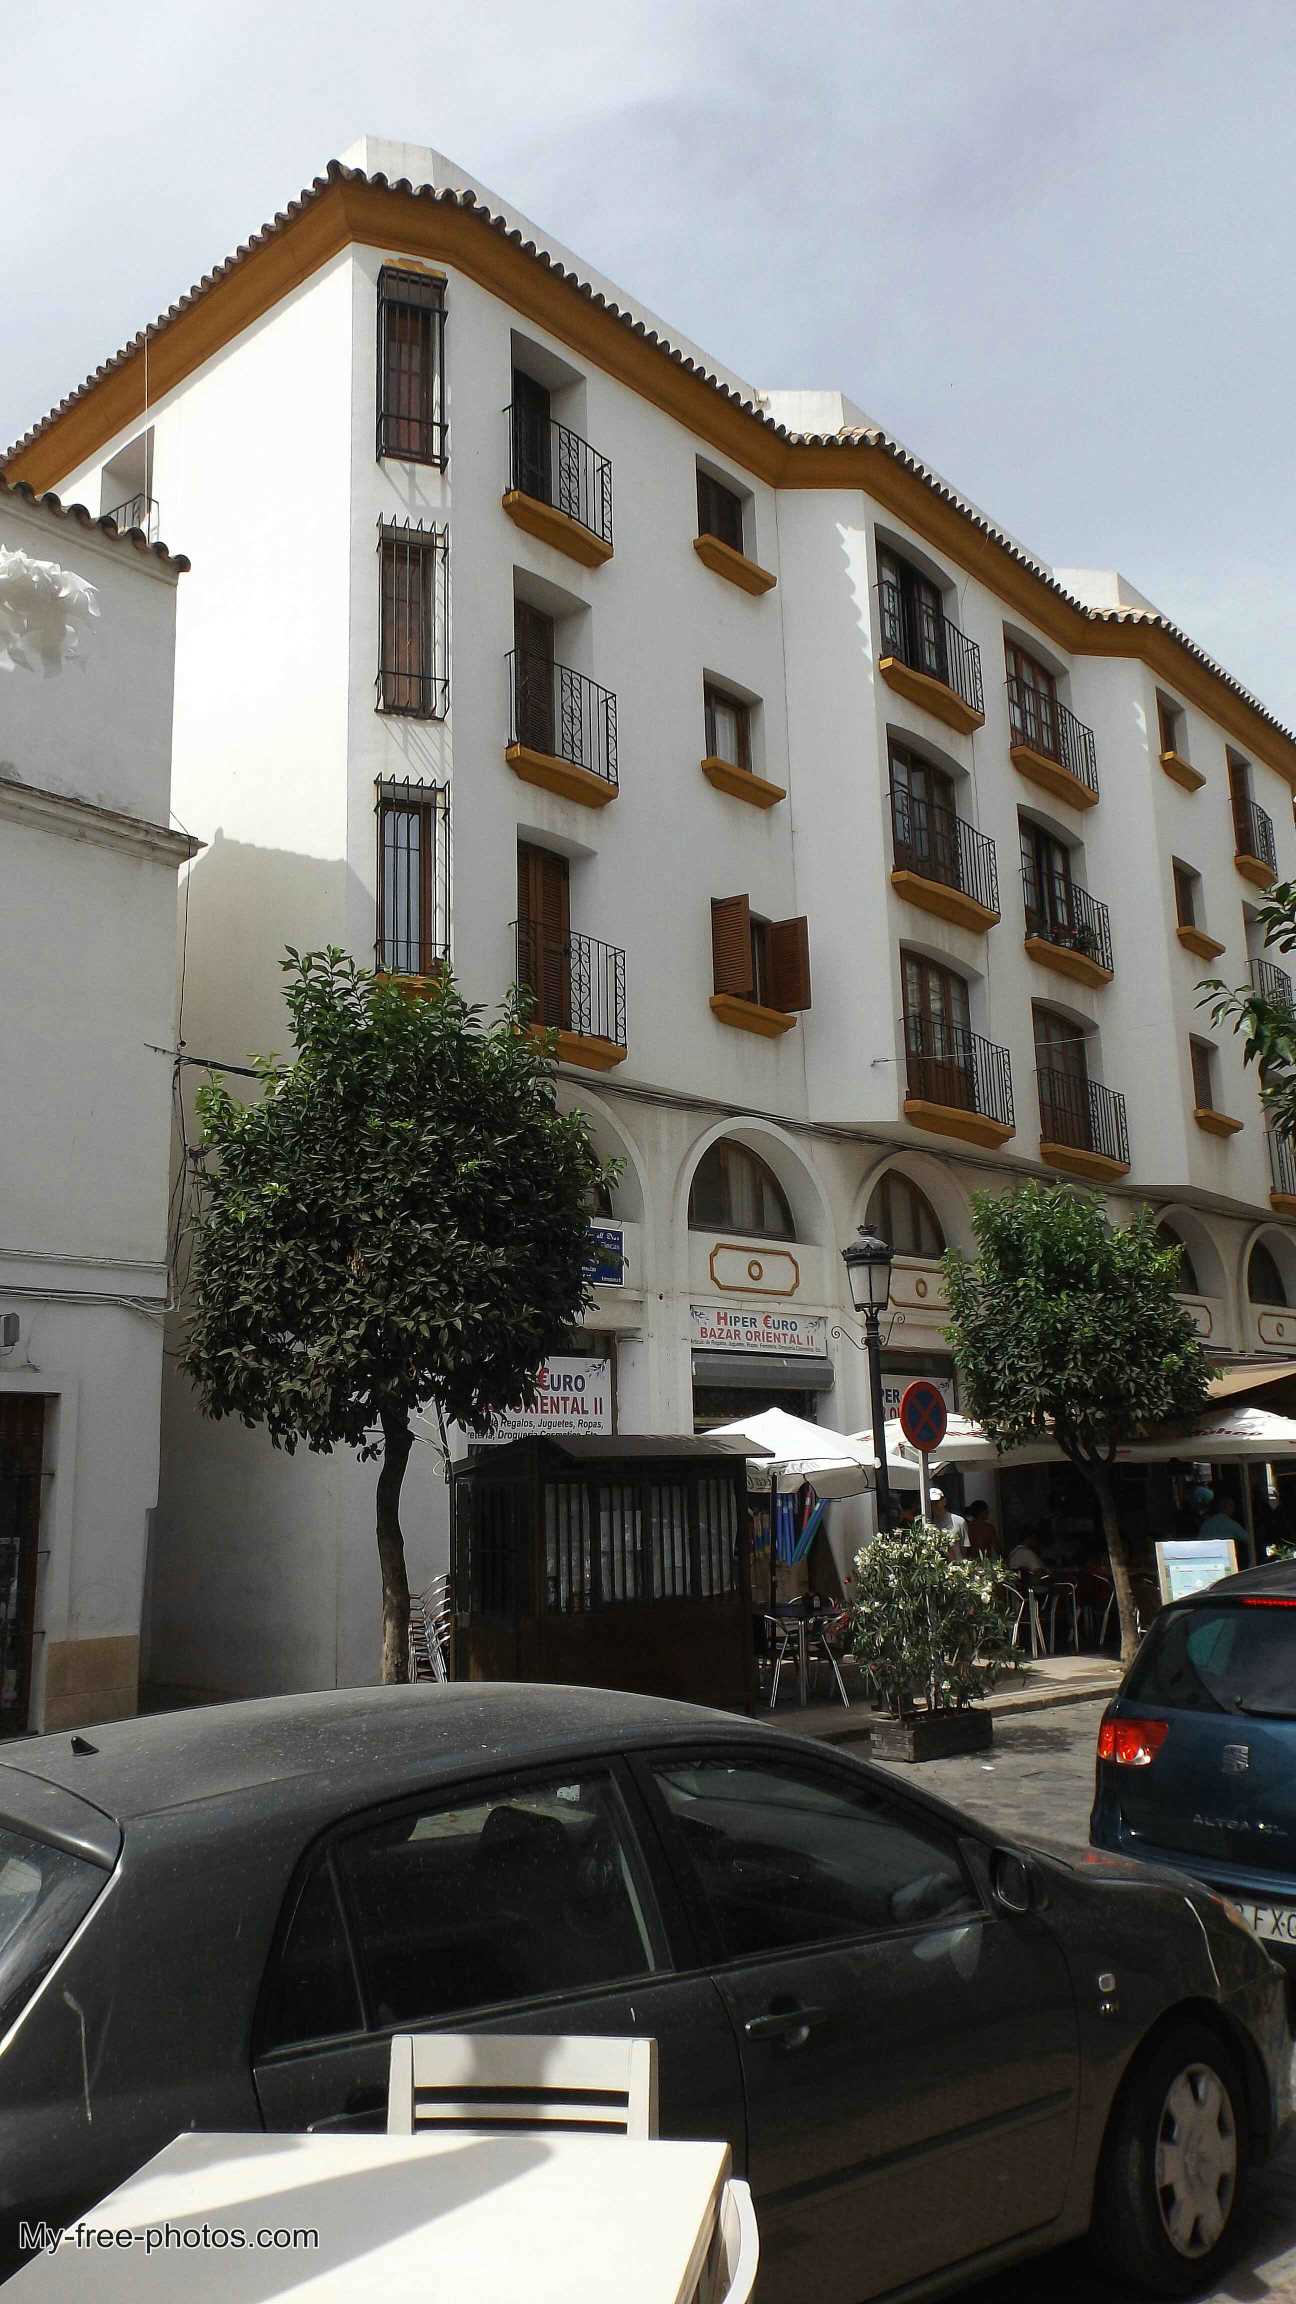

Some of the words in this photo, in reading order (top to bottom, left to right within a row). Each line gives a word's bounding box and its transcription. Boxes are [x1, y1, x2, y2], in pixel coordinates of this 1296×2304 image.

[716, 1311, 757, 1328] HIPER
[700, 1327, 740, 1340] BAZAR
[745, 1330, 803, 1346] ORIENTAL
[806, 1335, 814, 1346] II
[594, 1397, 603, 1415] II
[500, 1418, 536, 1429] Regalos,
[538, 1418, 576, 1429] Juguetes,
[577, 1418, 604, 1430] Ropas,
